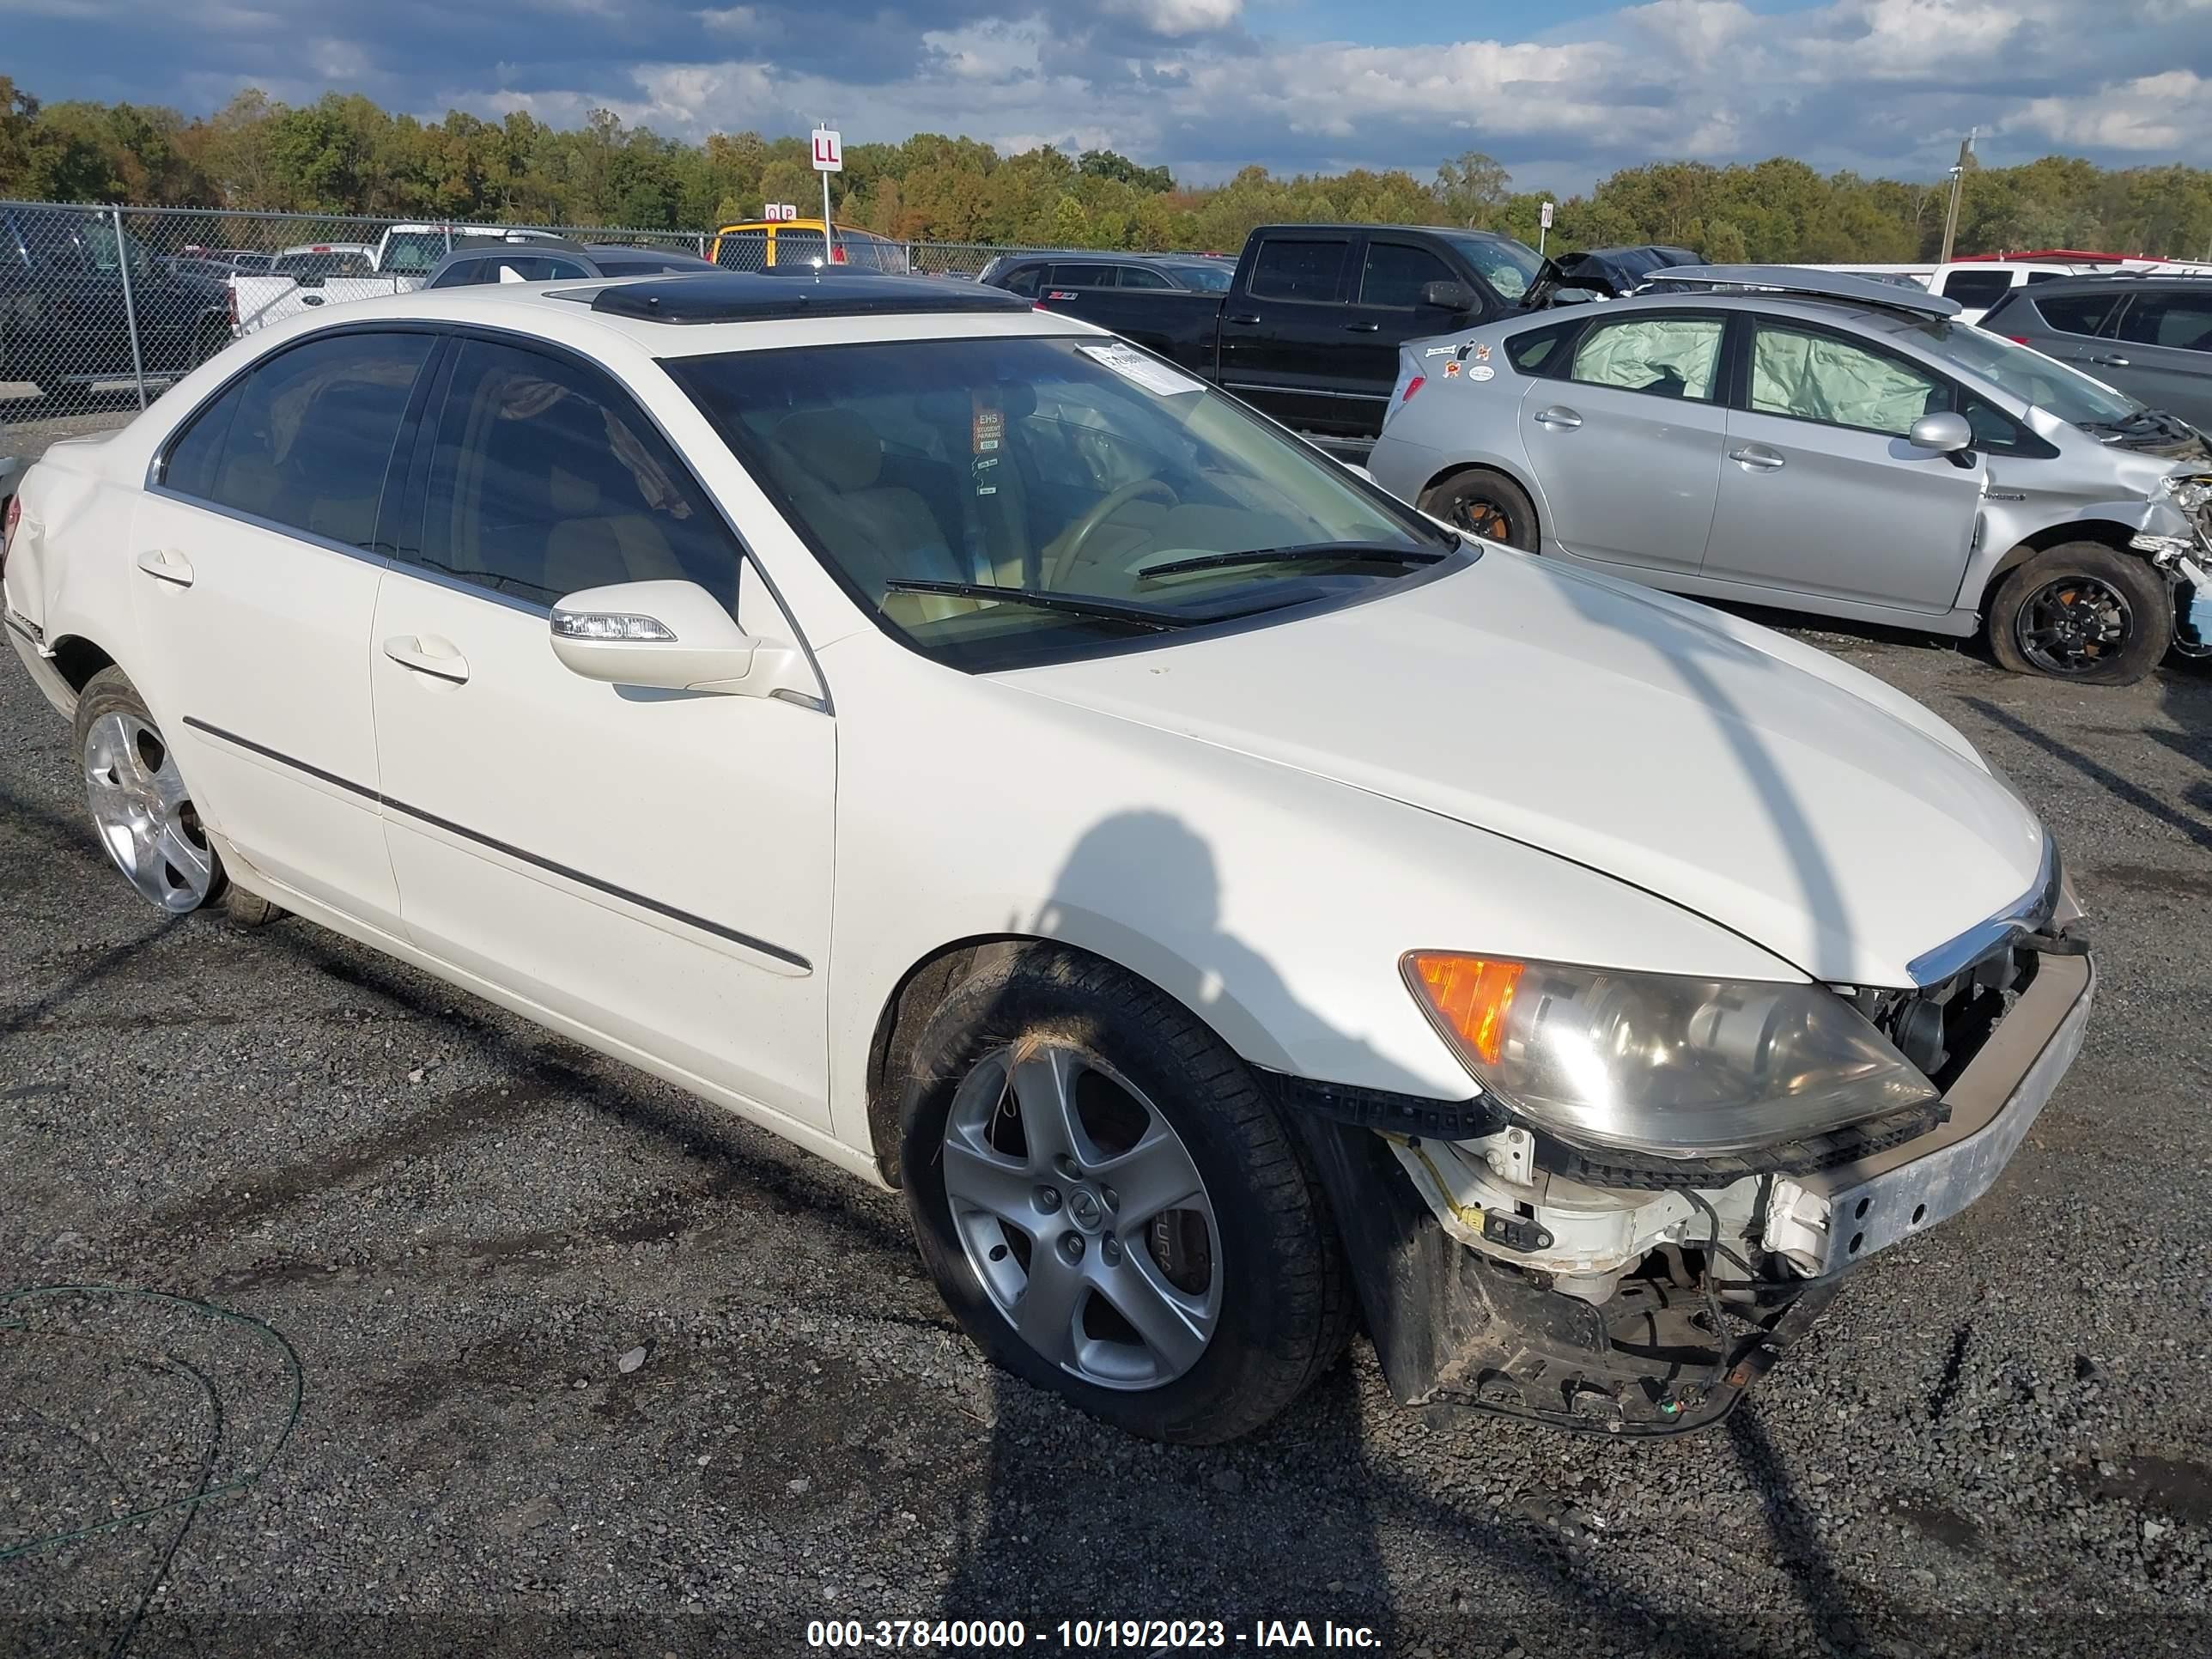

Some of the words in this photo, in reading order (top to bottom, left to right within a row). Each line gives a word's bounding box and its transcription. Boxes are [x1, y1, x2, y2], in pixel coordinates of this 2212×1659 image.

[815, 137, 839, 162] LL
[786, 209, 793, 220] P
[1543, 208, 1552, 222] 70
[1048, 291, 1079, 300] Z71
[979, 414, 998, 424] EHS
[1156, 1210, 1171, 1271] CURA
